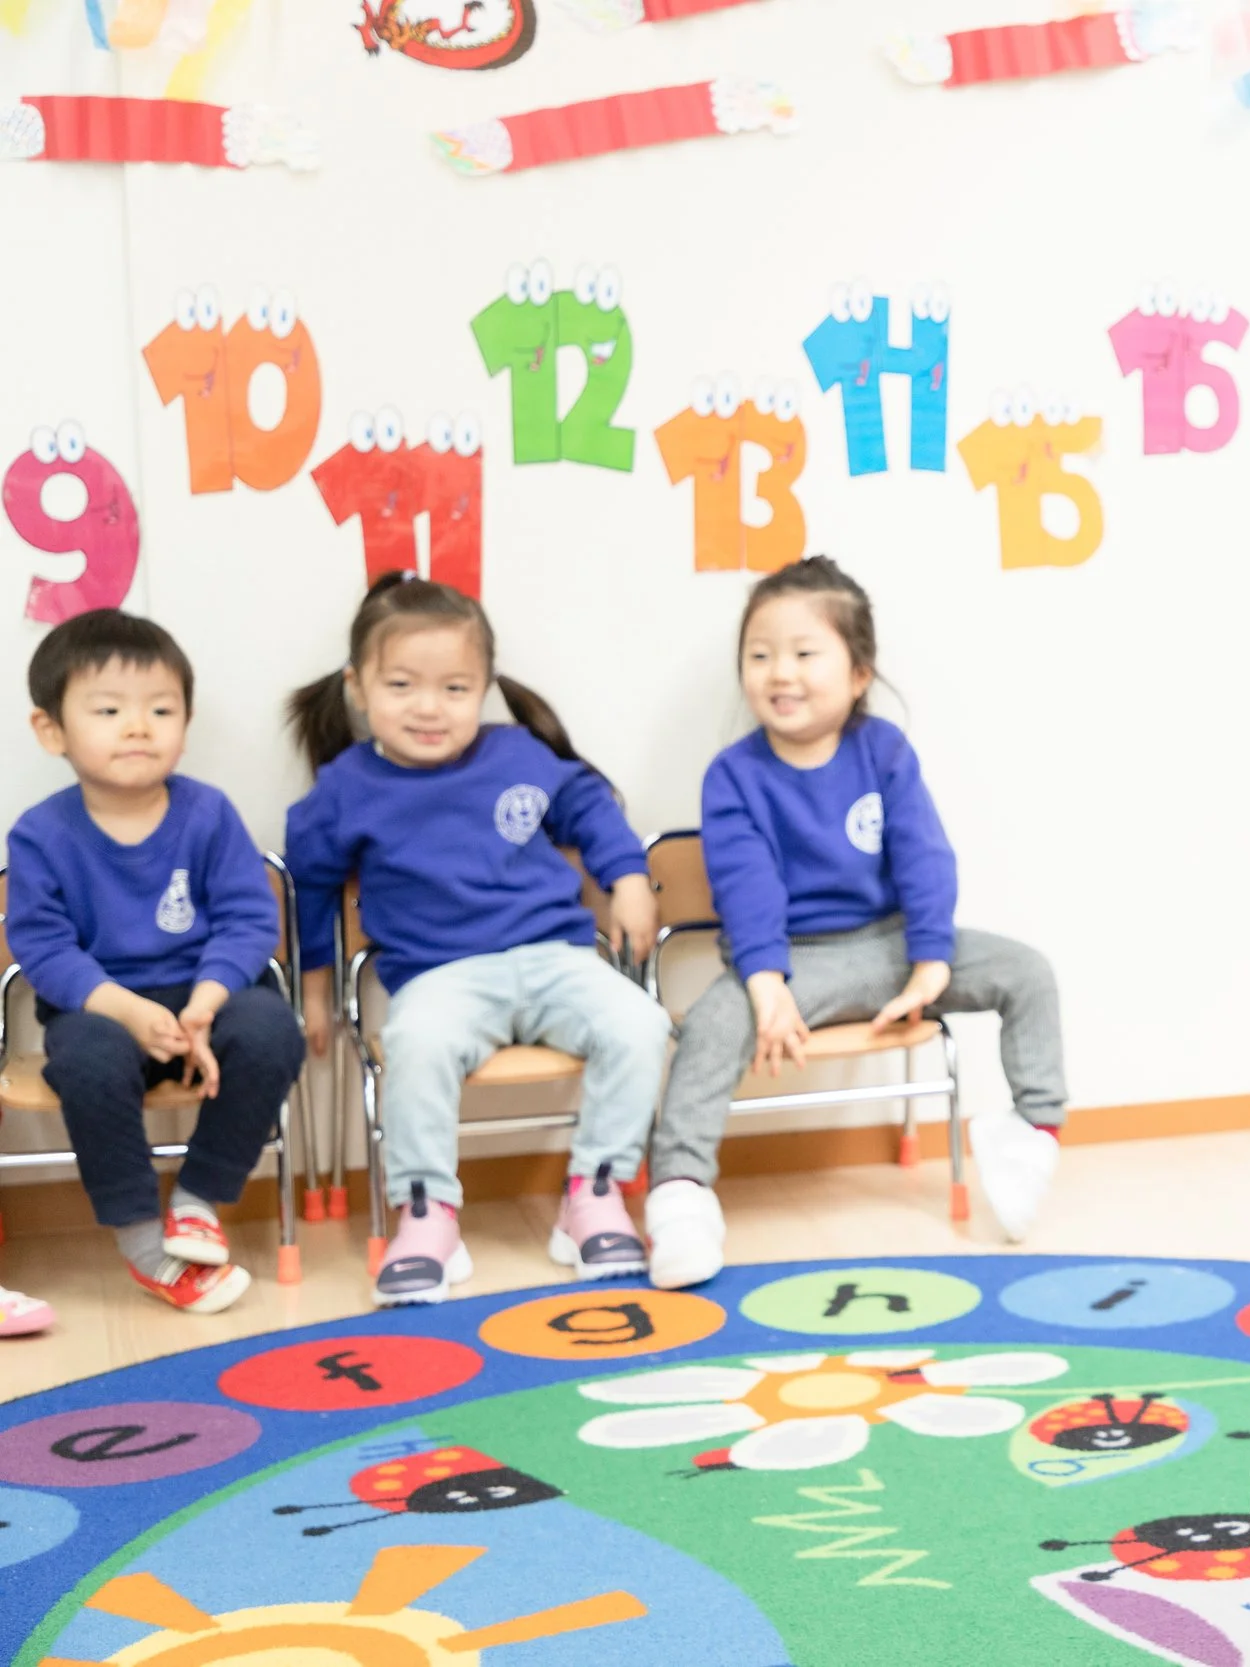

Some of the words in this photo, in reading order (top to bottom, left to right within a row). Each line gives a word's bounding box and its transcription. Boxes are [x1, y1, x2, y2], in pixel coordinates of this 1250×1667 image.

[142, 300, 322, 495] 10
[470, 284, 635, 473] 12
[1107, 298, 1250, 455] 16
[2, 437, 140, 626] 9
[654, 398, 807, 574] 13
[956, 412, 1104, 570] 15
[50, 1424, 196, 1462] e
[316, 1351, 383, 1392] f
[548, 1303, 655, 1346] g
[823, 1282, 911, 1313] h
[1090, 1279, 1148, 1313] i
